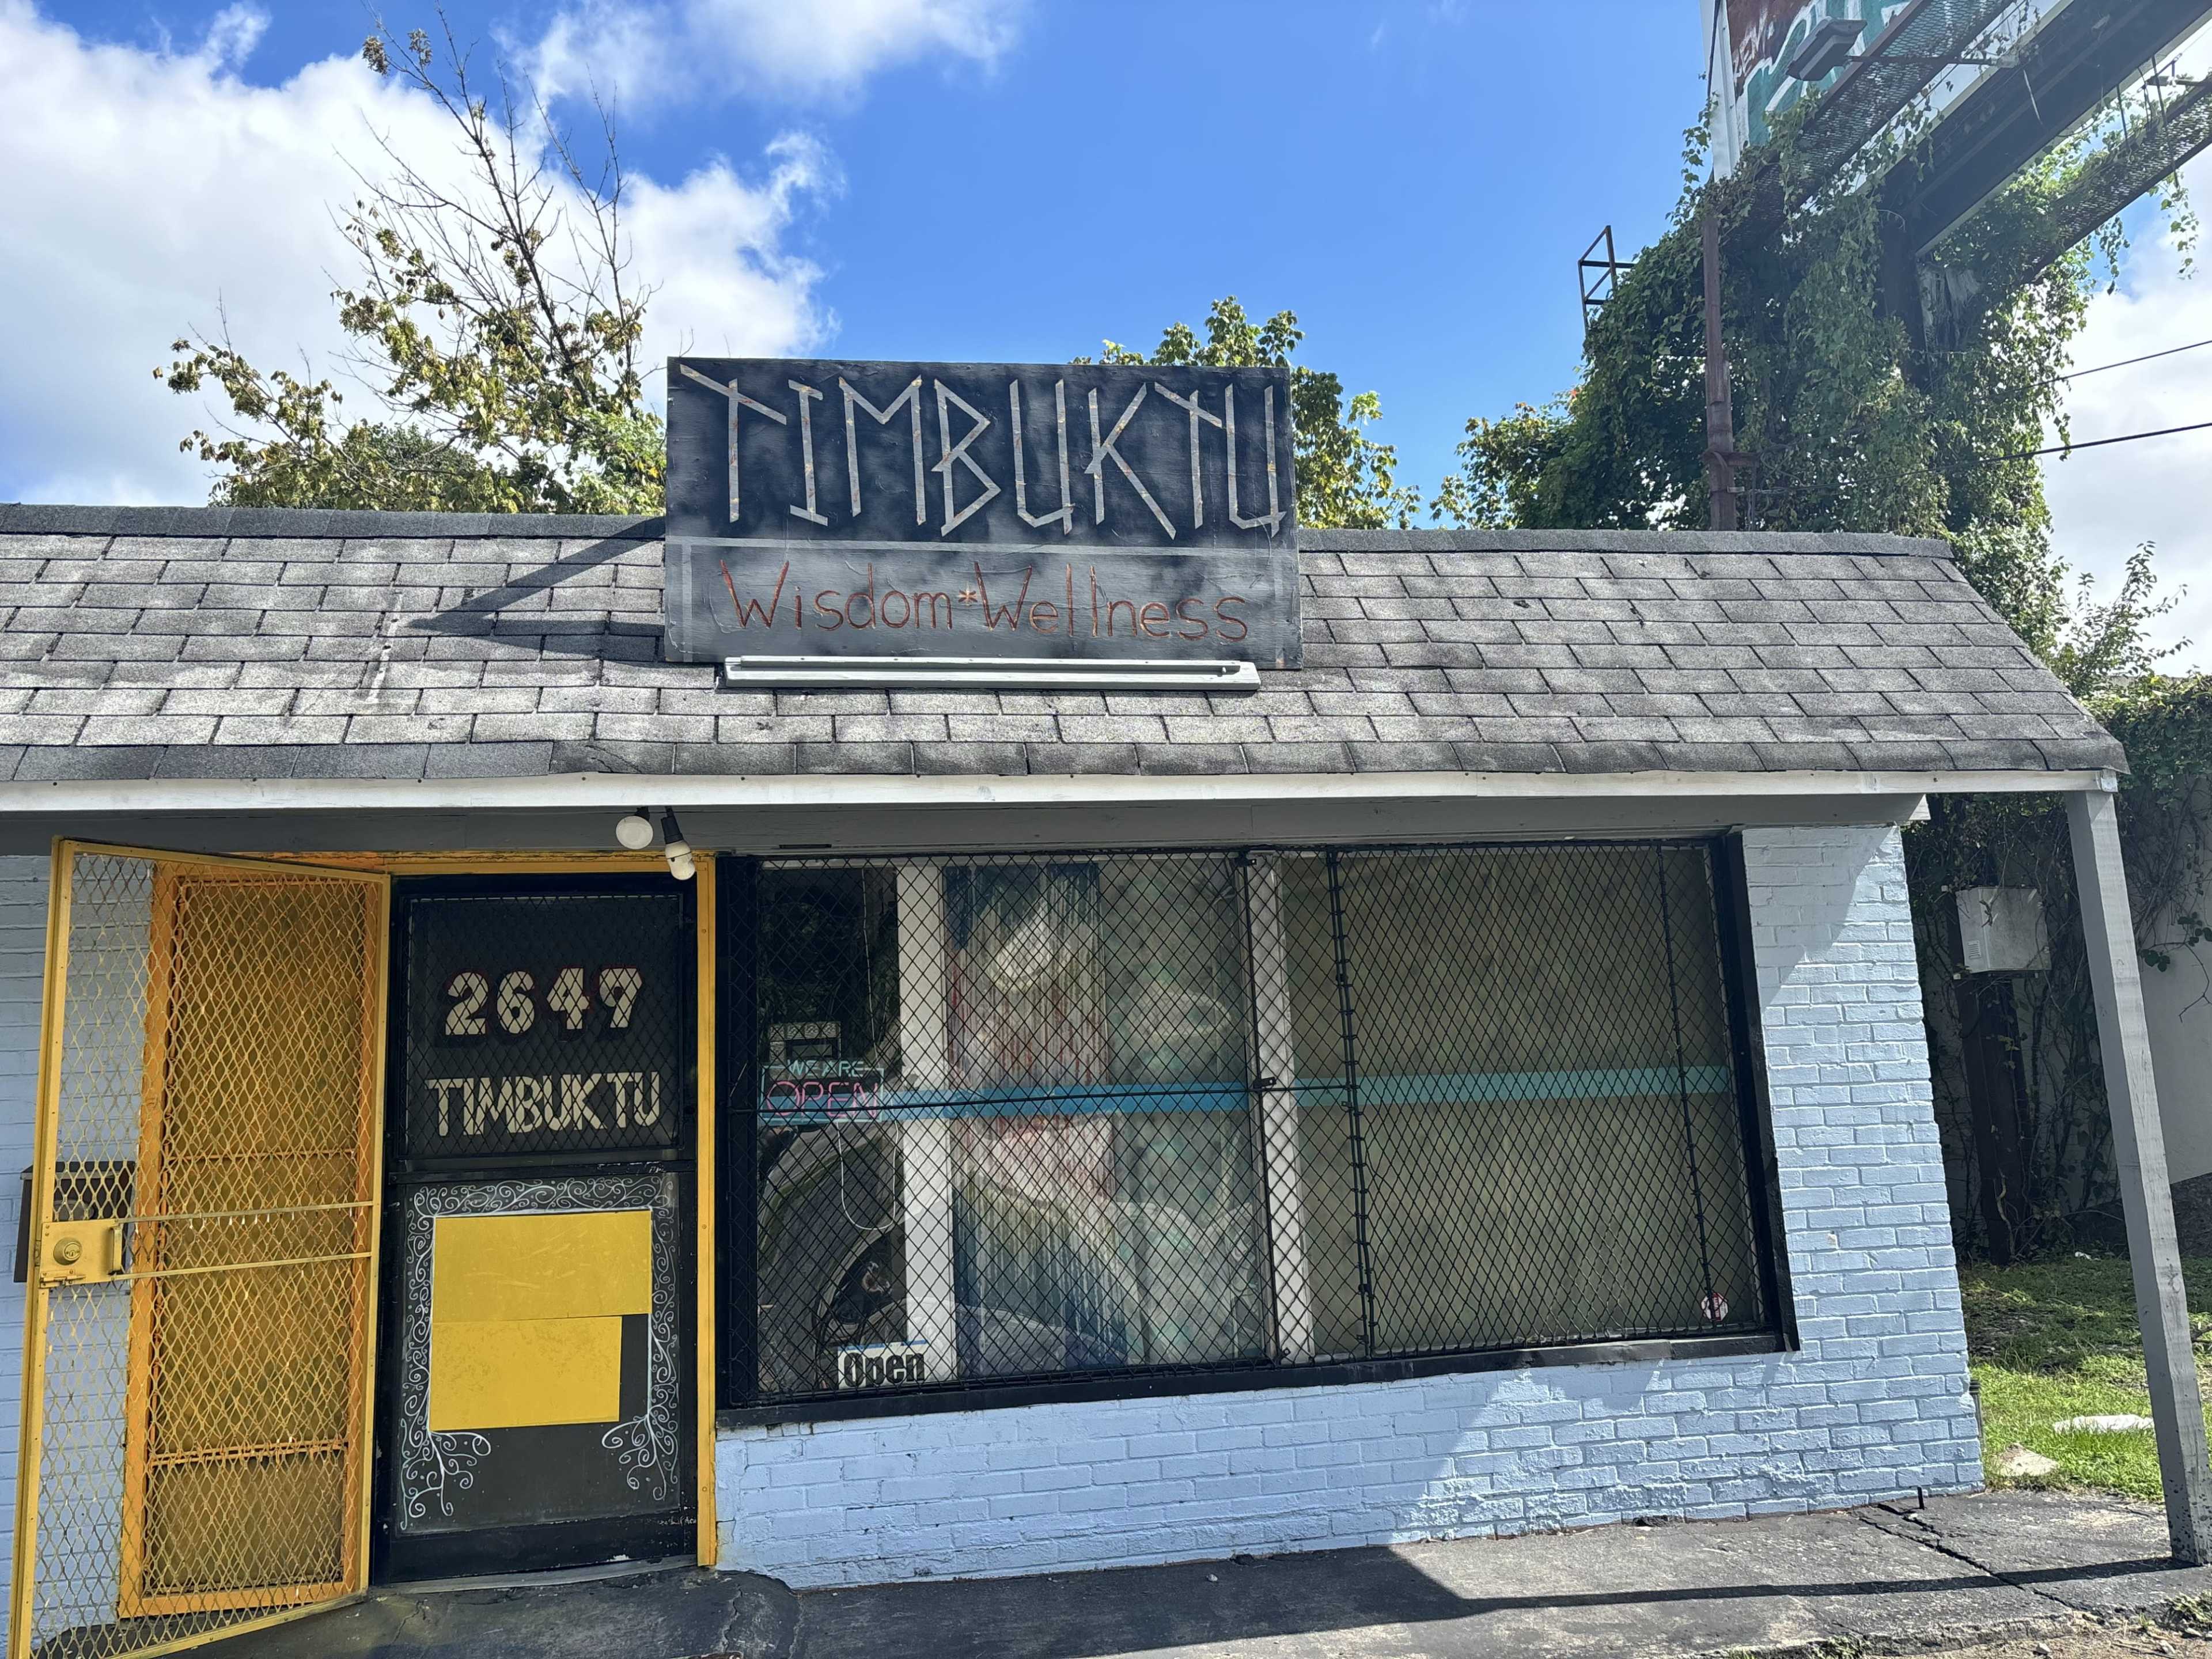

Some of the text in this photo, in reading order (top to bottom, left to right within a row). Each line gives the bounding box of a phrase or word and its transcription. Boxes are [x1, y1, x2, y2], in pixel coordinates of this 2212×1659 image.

[680, 363, 1286, 540] TIMBUKTU
[719, 558, 1249, 642] Wisdom Wellness
[445, 967, 642, 1035] 2649
[766, 1080, 878, 1118] OPEN
[787, 1059, 865, 1078] WE ARE
[425, 1071, 660, 1137] TIMBUKTU
[843, 1352, 925, 1388] Open
